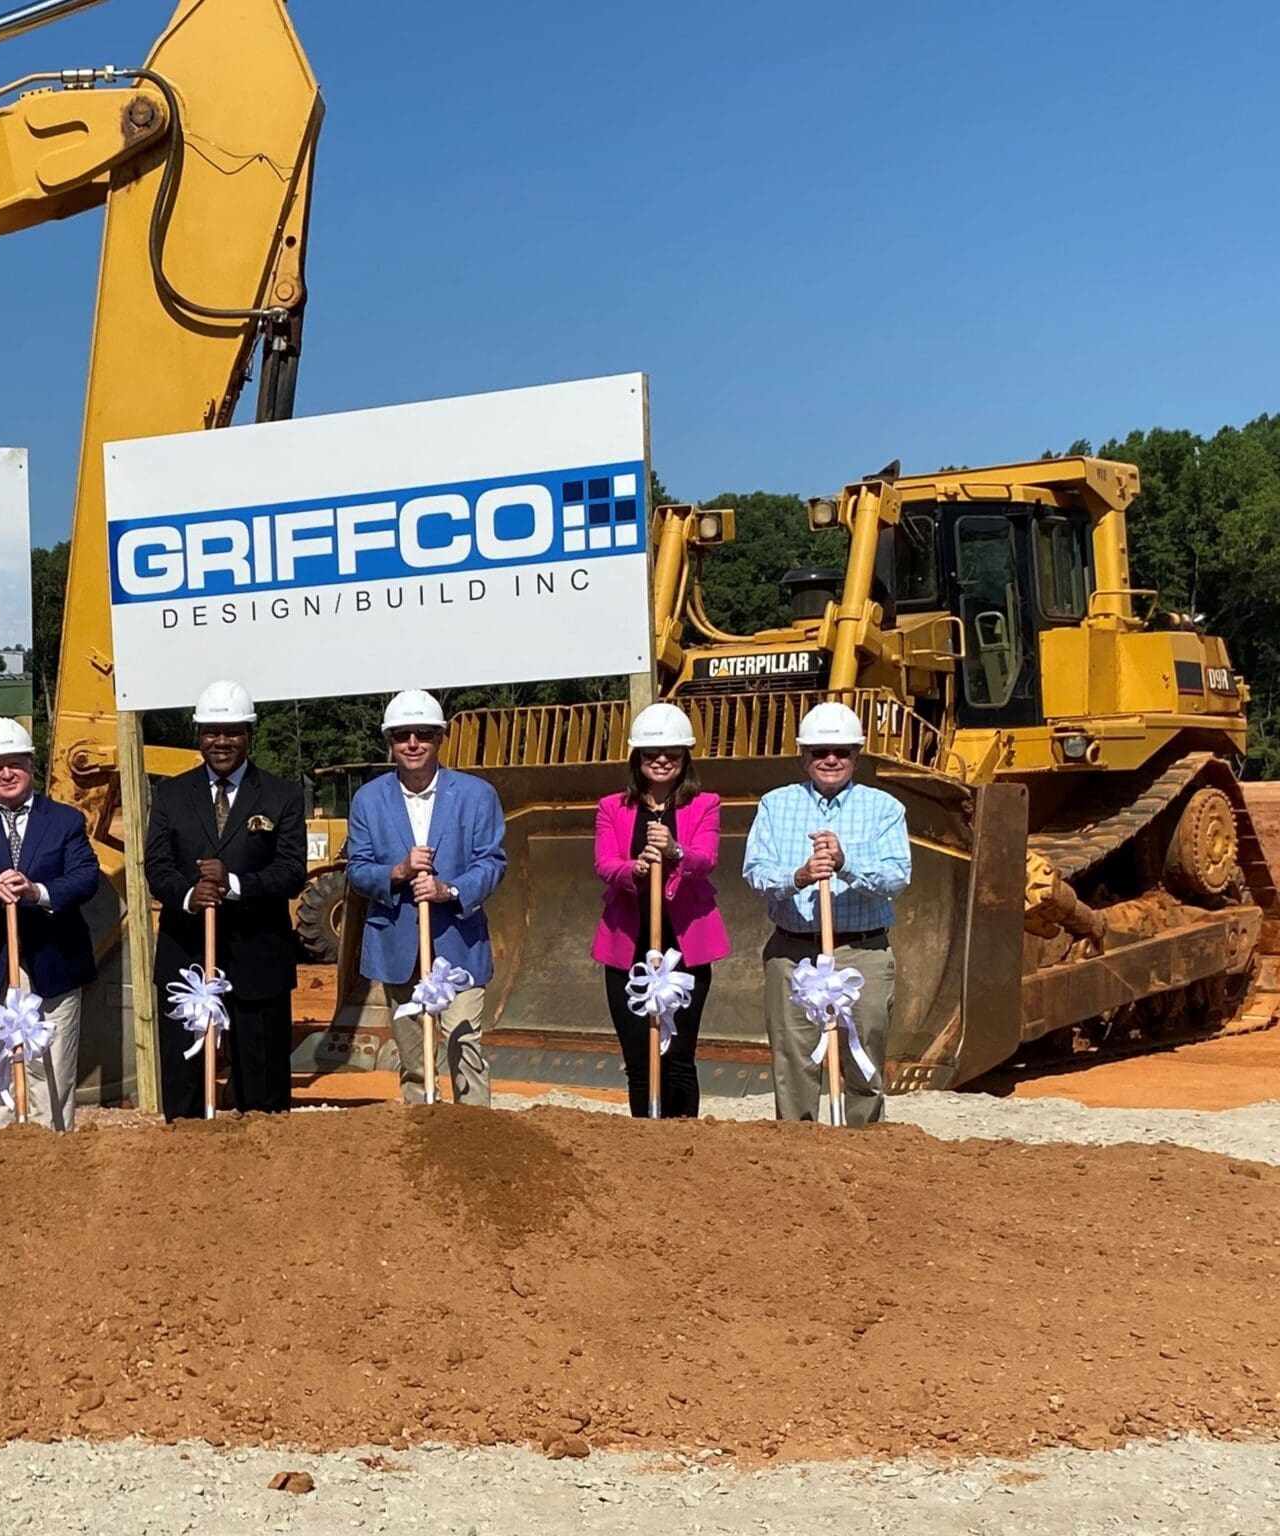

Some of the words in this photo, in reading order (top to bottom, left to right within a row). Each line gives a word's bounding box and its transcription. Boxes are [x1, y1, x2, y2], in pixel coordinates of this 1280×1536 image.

[117, 484, 554, 596] GRIFFCO
[162, 579, 486, 629] DESIGN/BUILD
[516, 568, 590, 597] INC
[709, 652, 809, 677] CATERPILLAR
[307, 840, 328, 860] AT
